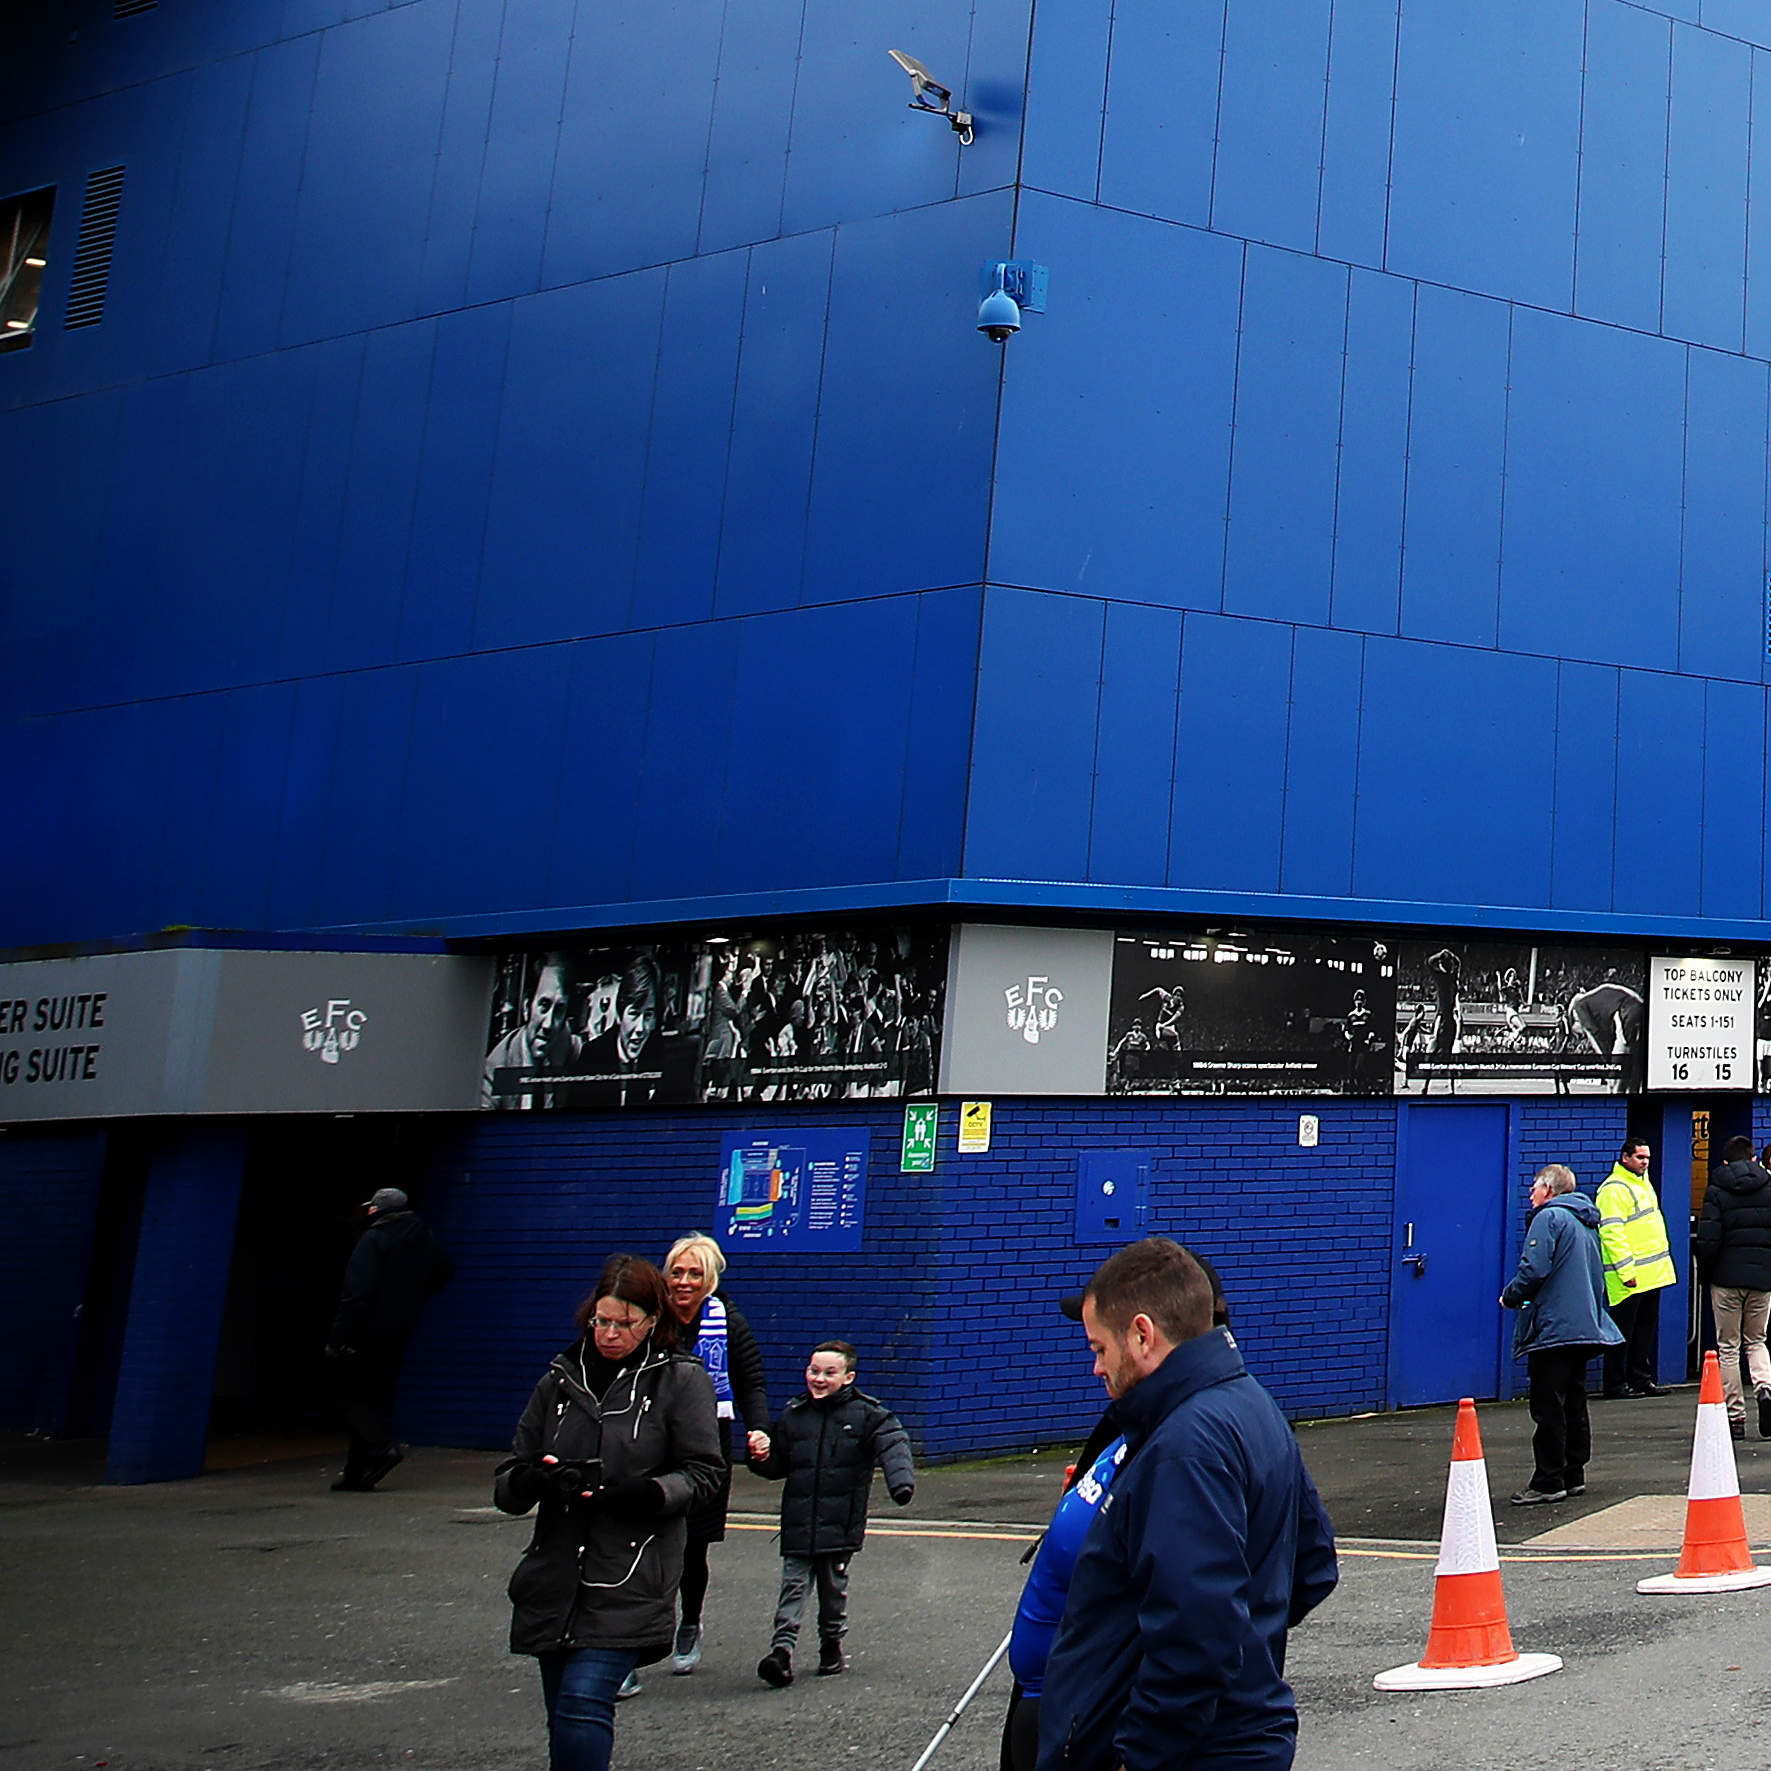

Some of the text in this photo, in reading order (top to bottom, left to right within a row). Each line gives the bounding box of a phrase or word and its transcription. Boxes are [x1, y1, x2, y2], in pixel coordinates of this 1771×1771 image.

[1663, 968, 1743, 983] TOP BALCONY
[1004, 976, 1065, 1010] EFC
[1663, 987, 1743, 1002] TICKETS ONLY
[34, 992, 107, 1032] SUITE
[301, 998, 368, 1030] EFC
[1671, 1014, 1735, 1029] SEATS 1-151
[1666, 1046, 1737, 1059] TURNSTILES
[26, 1043, 100, 1084] SUITE
[1672, 1063, 1732, 1080] 16 15
